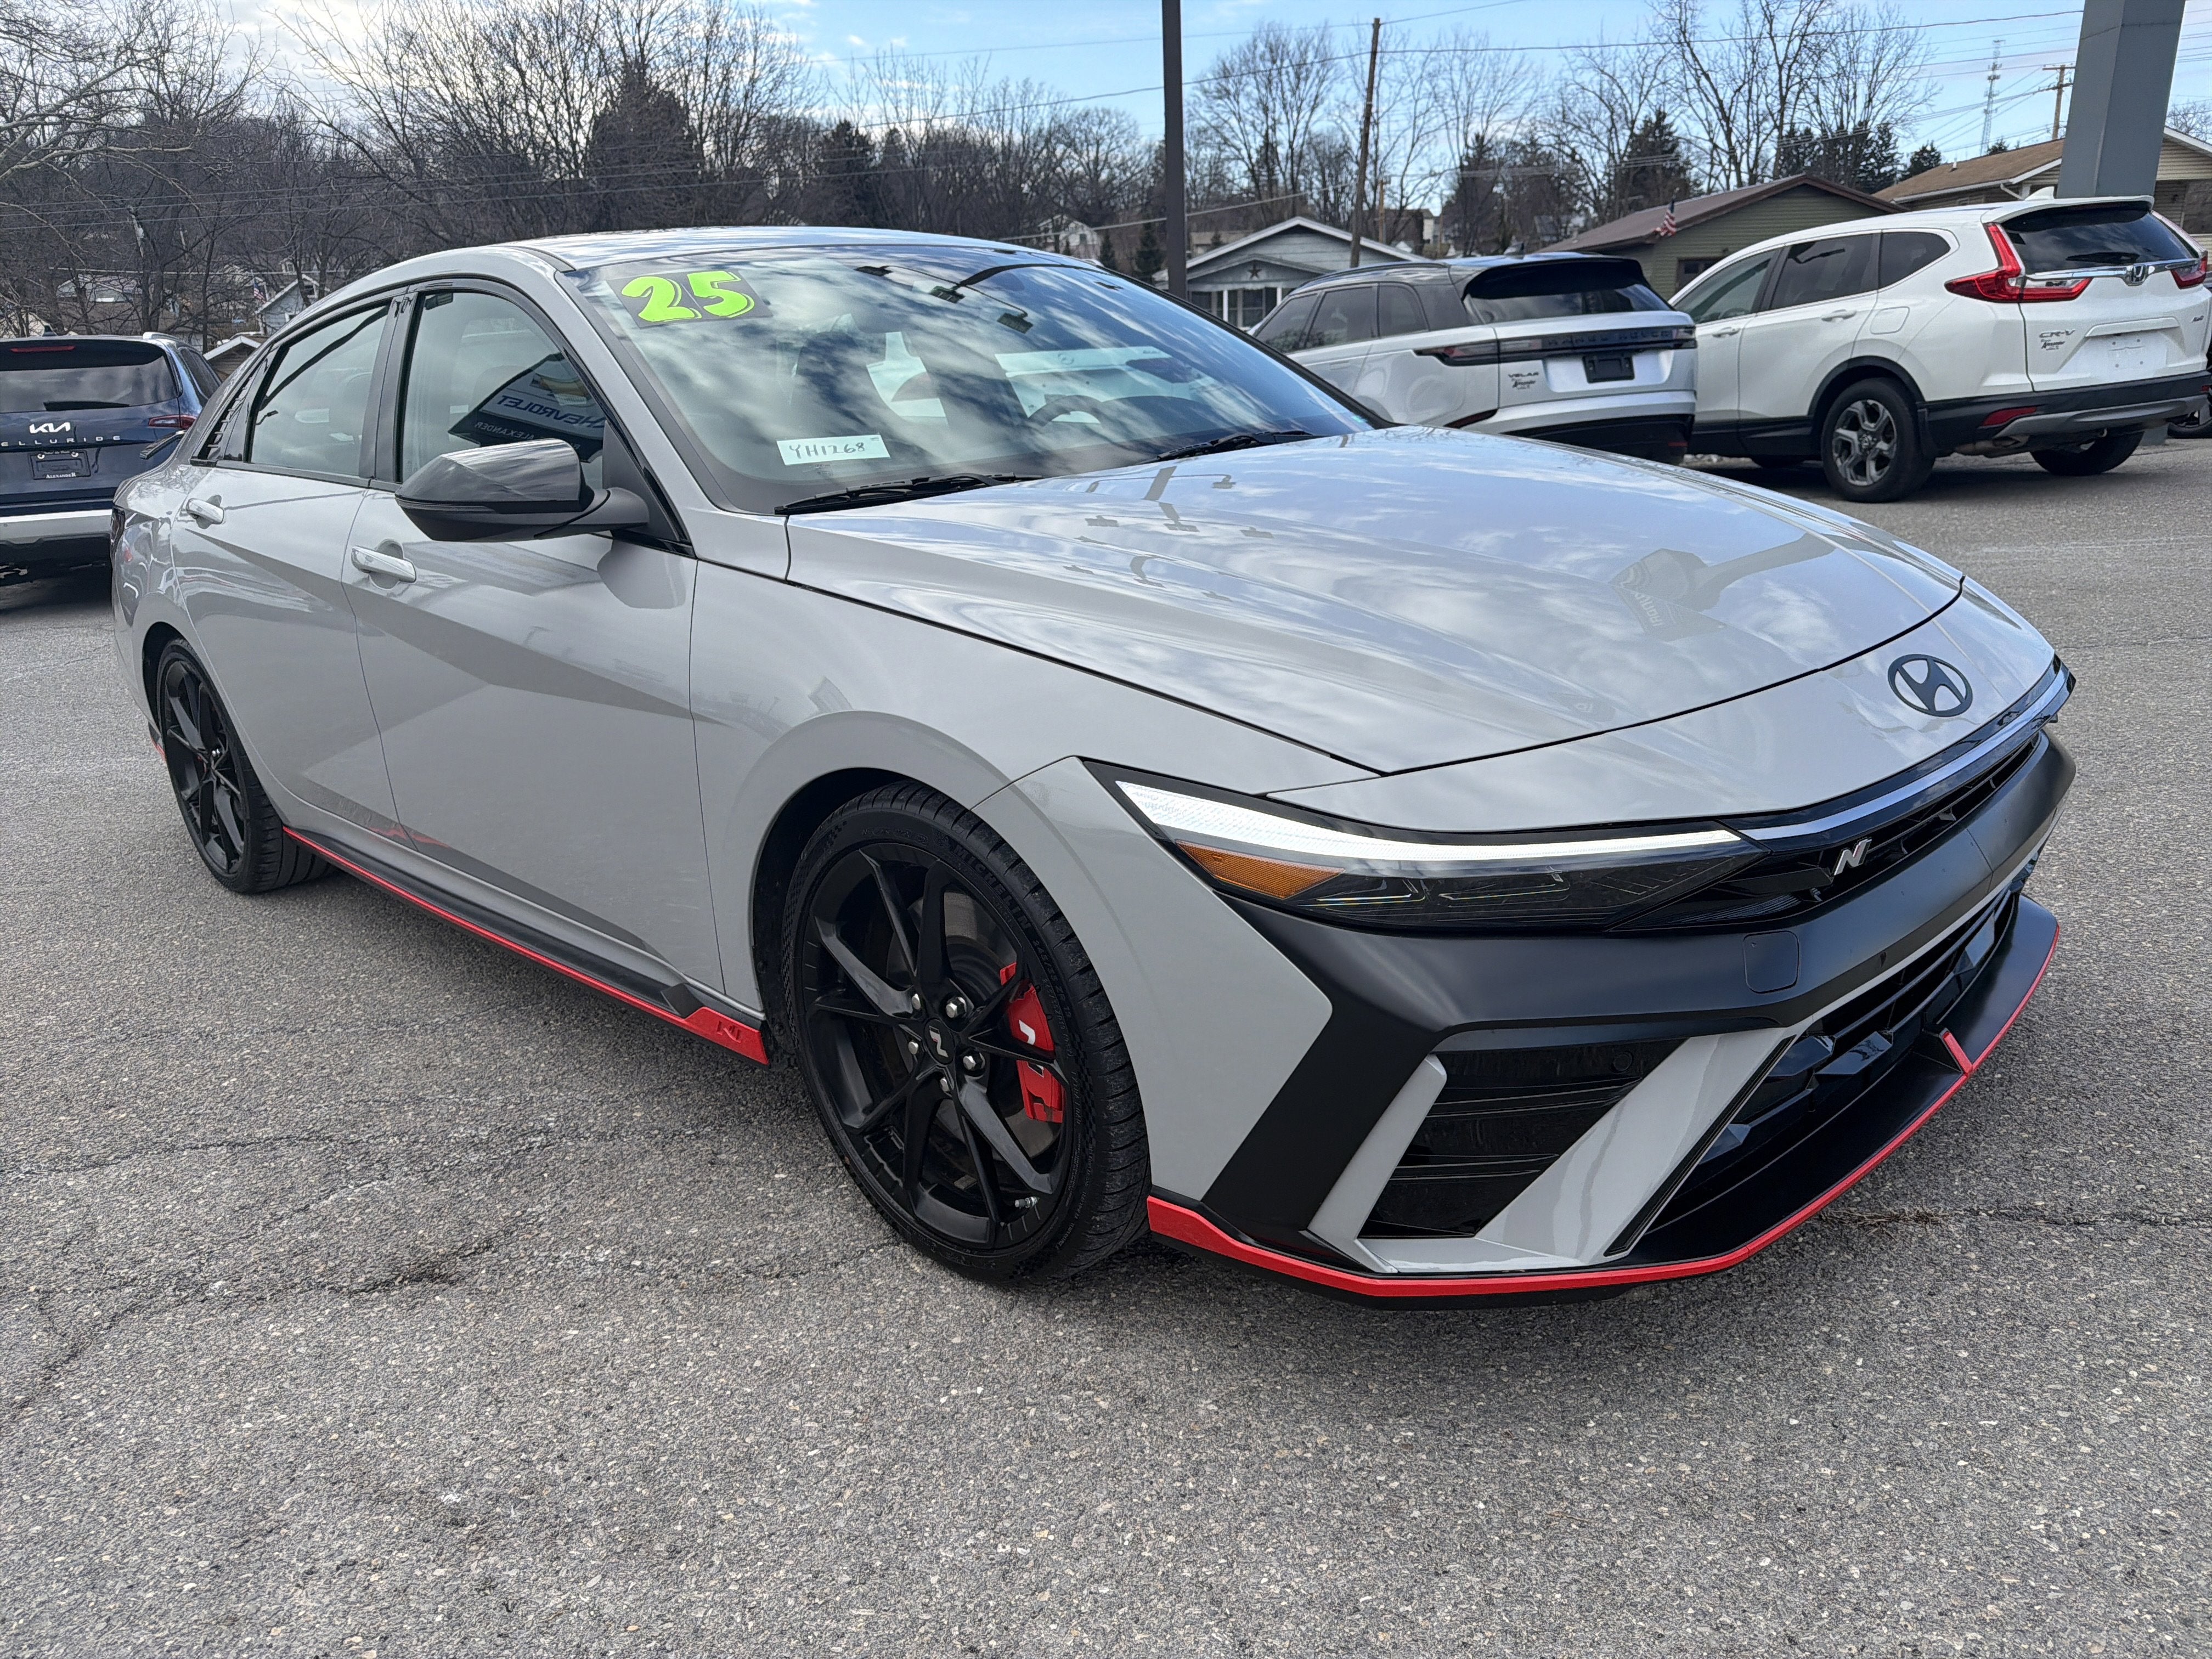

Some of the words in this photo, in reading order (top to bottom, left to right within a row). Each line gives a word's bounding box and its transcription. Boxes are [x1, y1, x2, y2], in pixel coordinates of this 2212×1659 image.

[621, 270, 755, 318] 25
[2039, 330, 2075, 338] CR-V
[29, 422, 71, 434] KIA
[1, 436, 121, 447] ELLURIDE
[953, 844, 1032, 929] MICHELIN
